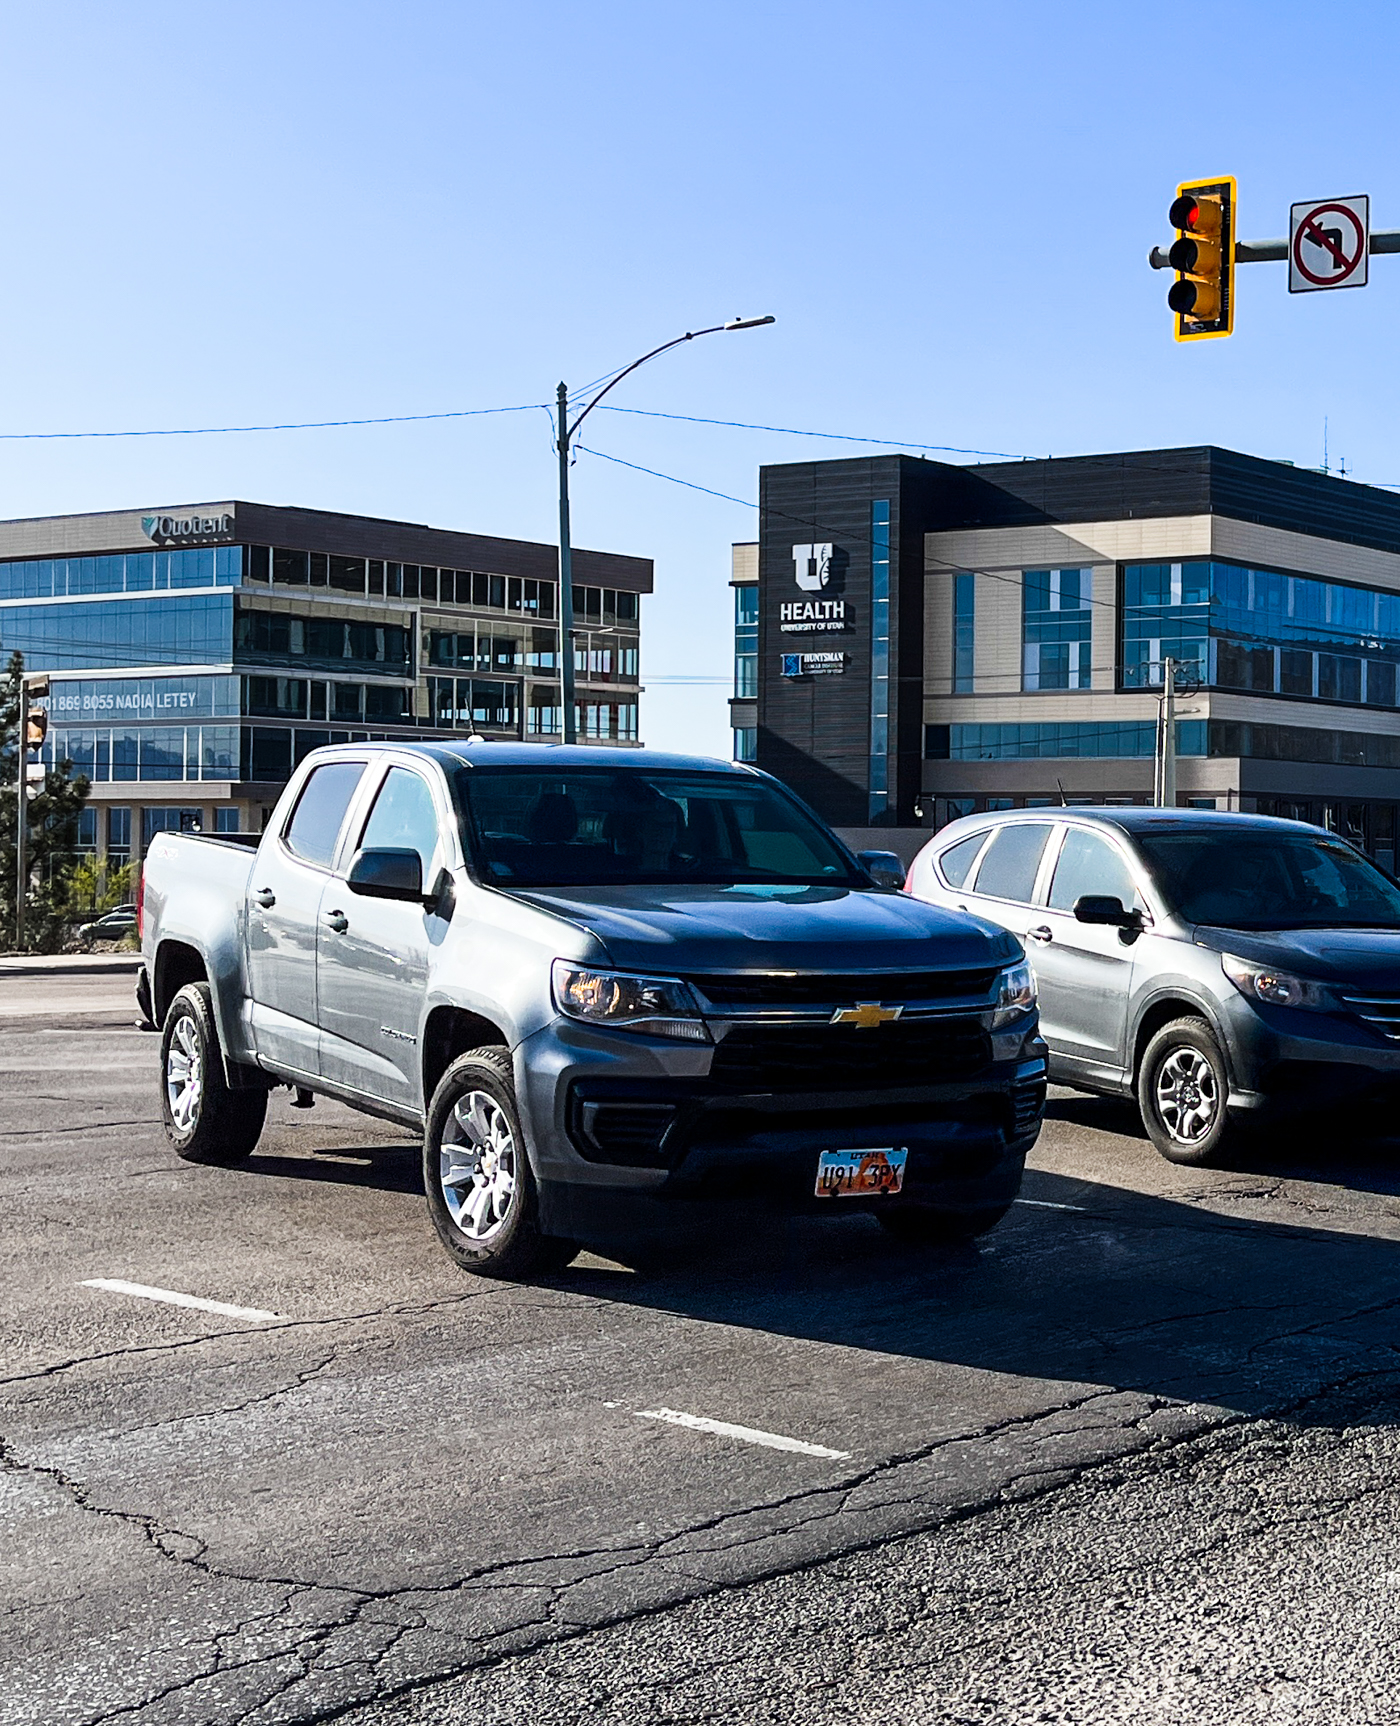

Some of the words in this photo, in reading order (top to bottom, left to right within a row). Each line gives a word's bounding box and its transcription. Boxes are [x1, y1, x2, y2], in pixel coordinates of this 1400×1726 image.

[159, 515, 229, 537] Quotient
[780, 601, 845, 620] HEALTH
[83, 694, 114, 710] 8055
[115, 693, 151, 709] NADIA
[156, 692, 196, 708] LETEY
[823, 1165, 854, 1189] U91
[868, 1164, 902, 1188] 3PX
